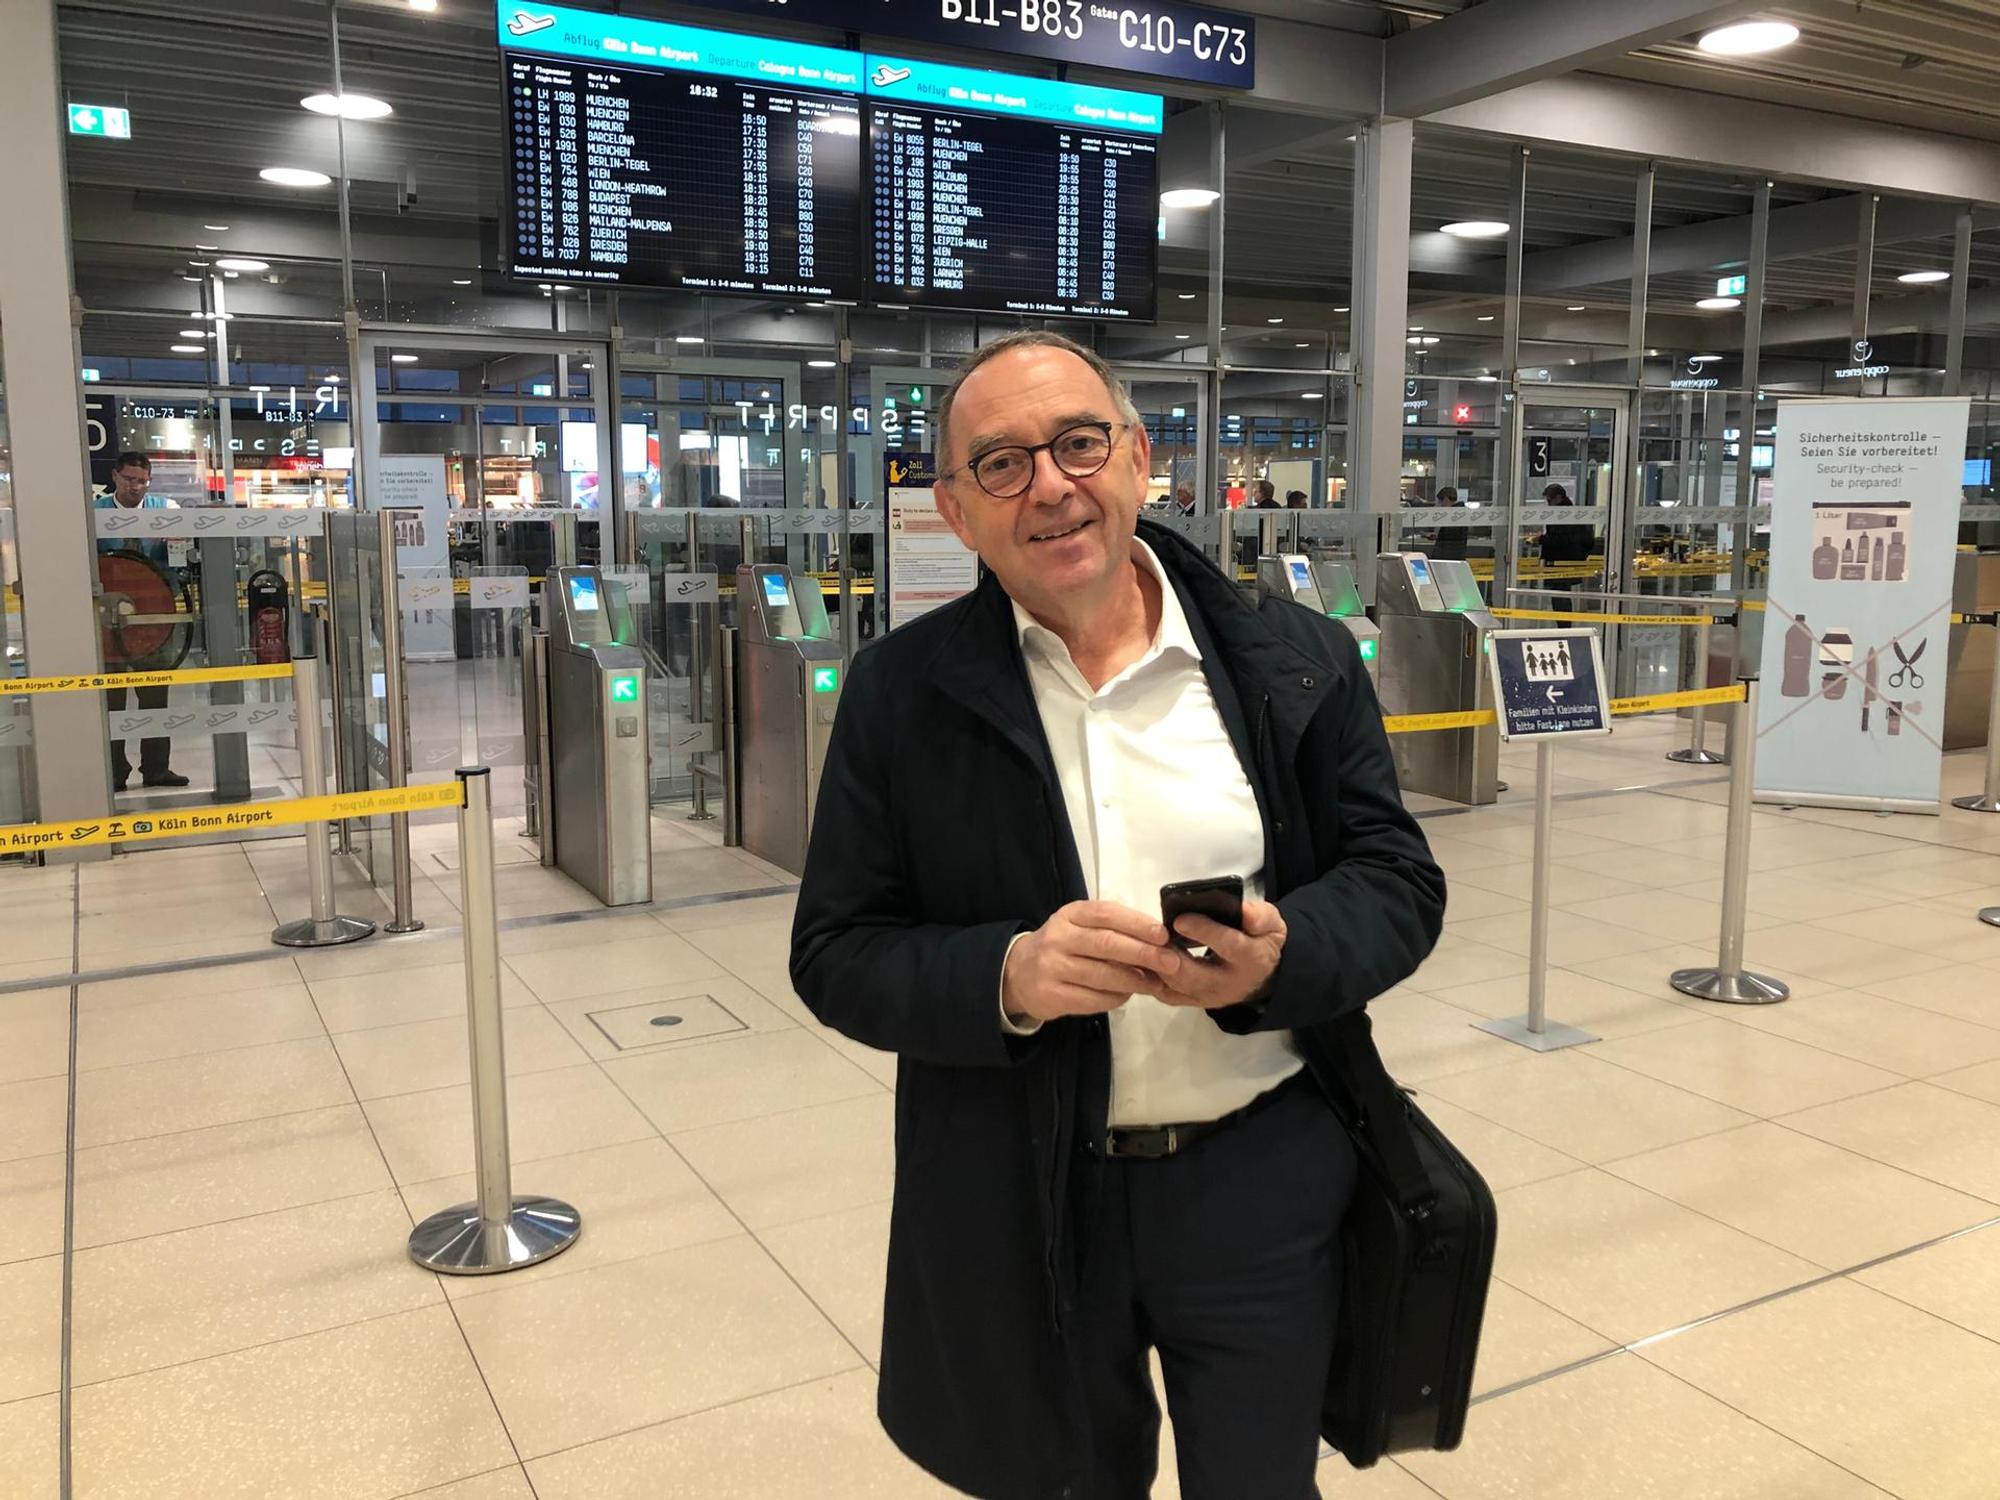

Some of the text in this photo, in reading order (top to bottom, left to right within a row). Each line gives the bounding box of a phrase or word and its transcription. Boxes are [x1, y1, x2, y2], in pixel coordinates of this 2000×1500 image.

[941, 0, 1247, 65] B11-B83 Gates C10-C73
[564, 32, 600, 50] Abflug
[708, 52, 756, 71] Departure
[917, 83, 947, 97] Abflug
[537, 88, 549, 99] LH
[586, 94, 629, 109] MUENCHEN
[742, 113, 766, 126] 16:50
[537, 100, 550, 111] EW
[586, 106, 629, 121] MUENCHEN
[742, 125, 767, 137] 17:15
[538, 113, 550, 124] EW
[587, 118, 624, 133] HAMBURG
[743, 136, 767, 149] 17:30
[538, 125, 550, 136] EW
[587, 130, 635, 146] BARCELONA
[743, 148, 767, 160] 17:35
[933, 137, 984, 153] BERLIN-TEGEL
[539, 138, 550, 148] LH
[587, 142, 630, 157] MUENCHEN
[743, 160, 767, 172] 17:55
[932, 148, 968, 161] MUENCHEN
[539, 150, 551, 161] EW
[588, 155, 650, 171] BERLIN-TEGEL
[743, 171, 767, 183] 18:15
[932, 160, 951, 170] WIEN
[540, 162, 552, 173] EW
[588, 167, 610, 179] WIEN
[743, 183, 767, 195] 18:15
[933, 170, 967, 183] SALZBURG
[540, 174, 552, 185] EW
[589, 179, 666, 196] LONDON-HEATHROW
[744, 194, 768, 206] 18:20
[932, 181, 968, 194] MUENCHEN
[540, 186, 552, 197] EW
[589, 191, 631, 204] BUDAPEST
[744, 205, 768, 217] 18:45
[932, 193, 968, 205] MUENCHEN
[541, 198, 553, 209] EW
[589, 203, 632, 216] MUENCHEN
[744, 217, 768, 229] 18:50
[933, 203, 984, 217] BERLIN-TEGEL
[541, 211, 553, 222] EW
[589, 215, 672, 232] MAILAND-MALPENSA
[744, 228, 768, 240] 18:50
[932, 214, 968, 226] MUENCHEN
[933, 224, 963, 236] DRESDEN
[541, 223, 553, 234] EW
[590, 226, 627, 240] ZUERICH
[744, 240, 768, 252] 19:00
[933, 235, 988, 249] LEIPZIG-HALLE
[542, 235, 554, 246] EW
[590, 239, 627, 252] DRESDEN
[744, 251, 768, 263] 19:15
[932, 246, 951, 256] WIEN
[542, 247, 554, 258] EW
[590, 251, 628, 263] HAMBURG
[745, 263, 769, 274] 19:15
[933, 256, 963, 268] ZUERICH
[514, 264, 542, 275] Expected
[682, 277, 709, 286] Terminal
[762, 282, 788, 292] Terminal
[933, 278, 963, 290] HAMBURG
[134, 407, 175, 419] C10-73
[1799, 432, 1927, 443] Sicherheitskontrolle
[1534, 442, 1547, 472] 3
[1801, 446, 1938, 457] Seien Sie vorbereitet!
[909, 461, 922, 469] Zoll
[1817, 463, 1904, 475] Security-check
[1830, 478, 1902, 489] be prepared!
[4, 683, 23, 691] Bonn
[25, 680, 54, 691] Airport
[126, 675, 144, 683] Bonn
[146, 673, 173, 683] Airport
[1508, 708, 1540, 718] Familien
[1557, 704, 1598, 714] Kleinkindern
[1516, 721, 1535, 731] bitte
[1537, 720, 1552, 730] Fast
[12, 831, 64, 847] Airport
[158, 816, 187, 831] Köln
[192, 814, 222, 828] Bonn
[226, 809, 273, 826] Airport
